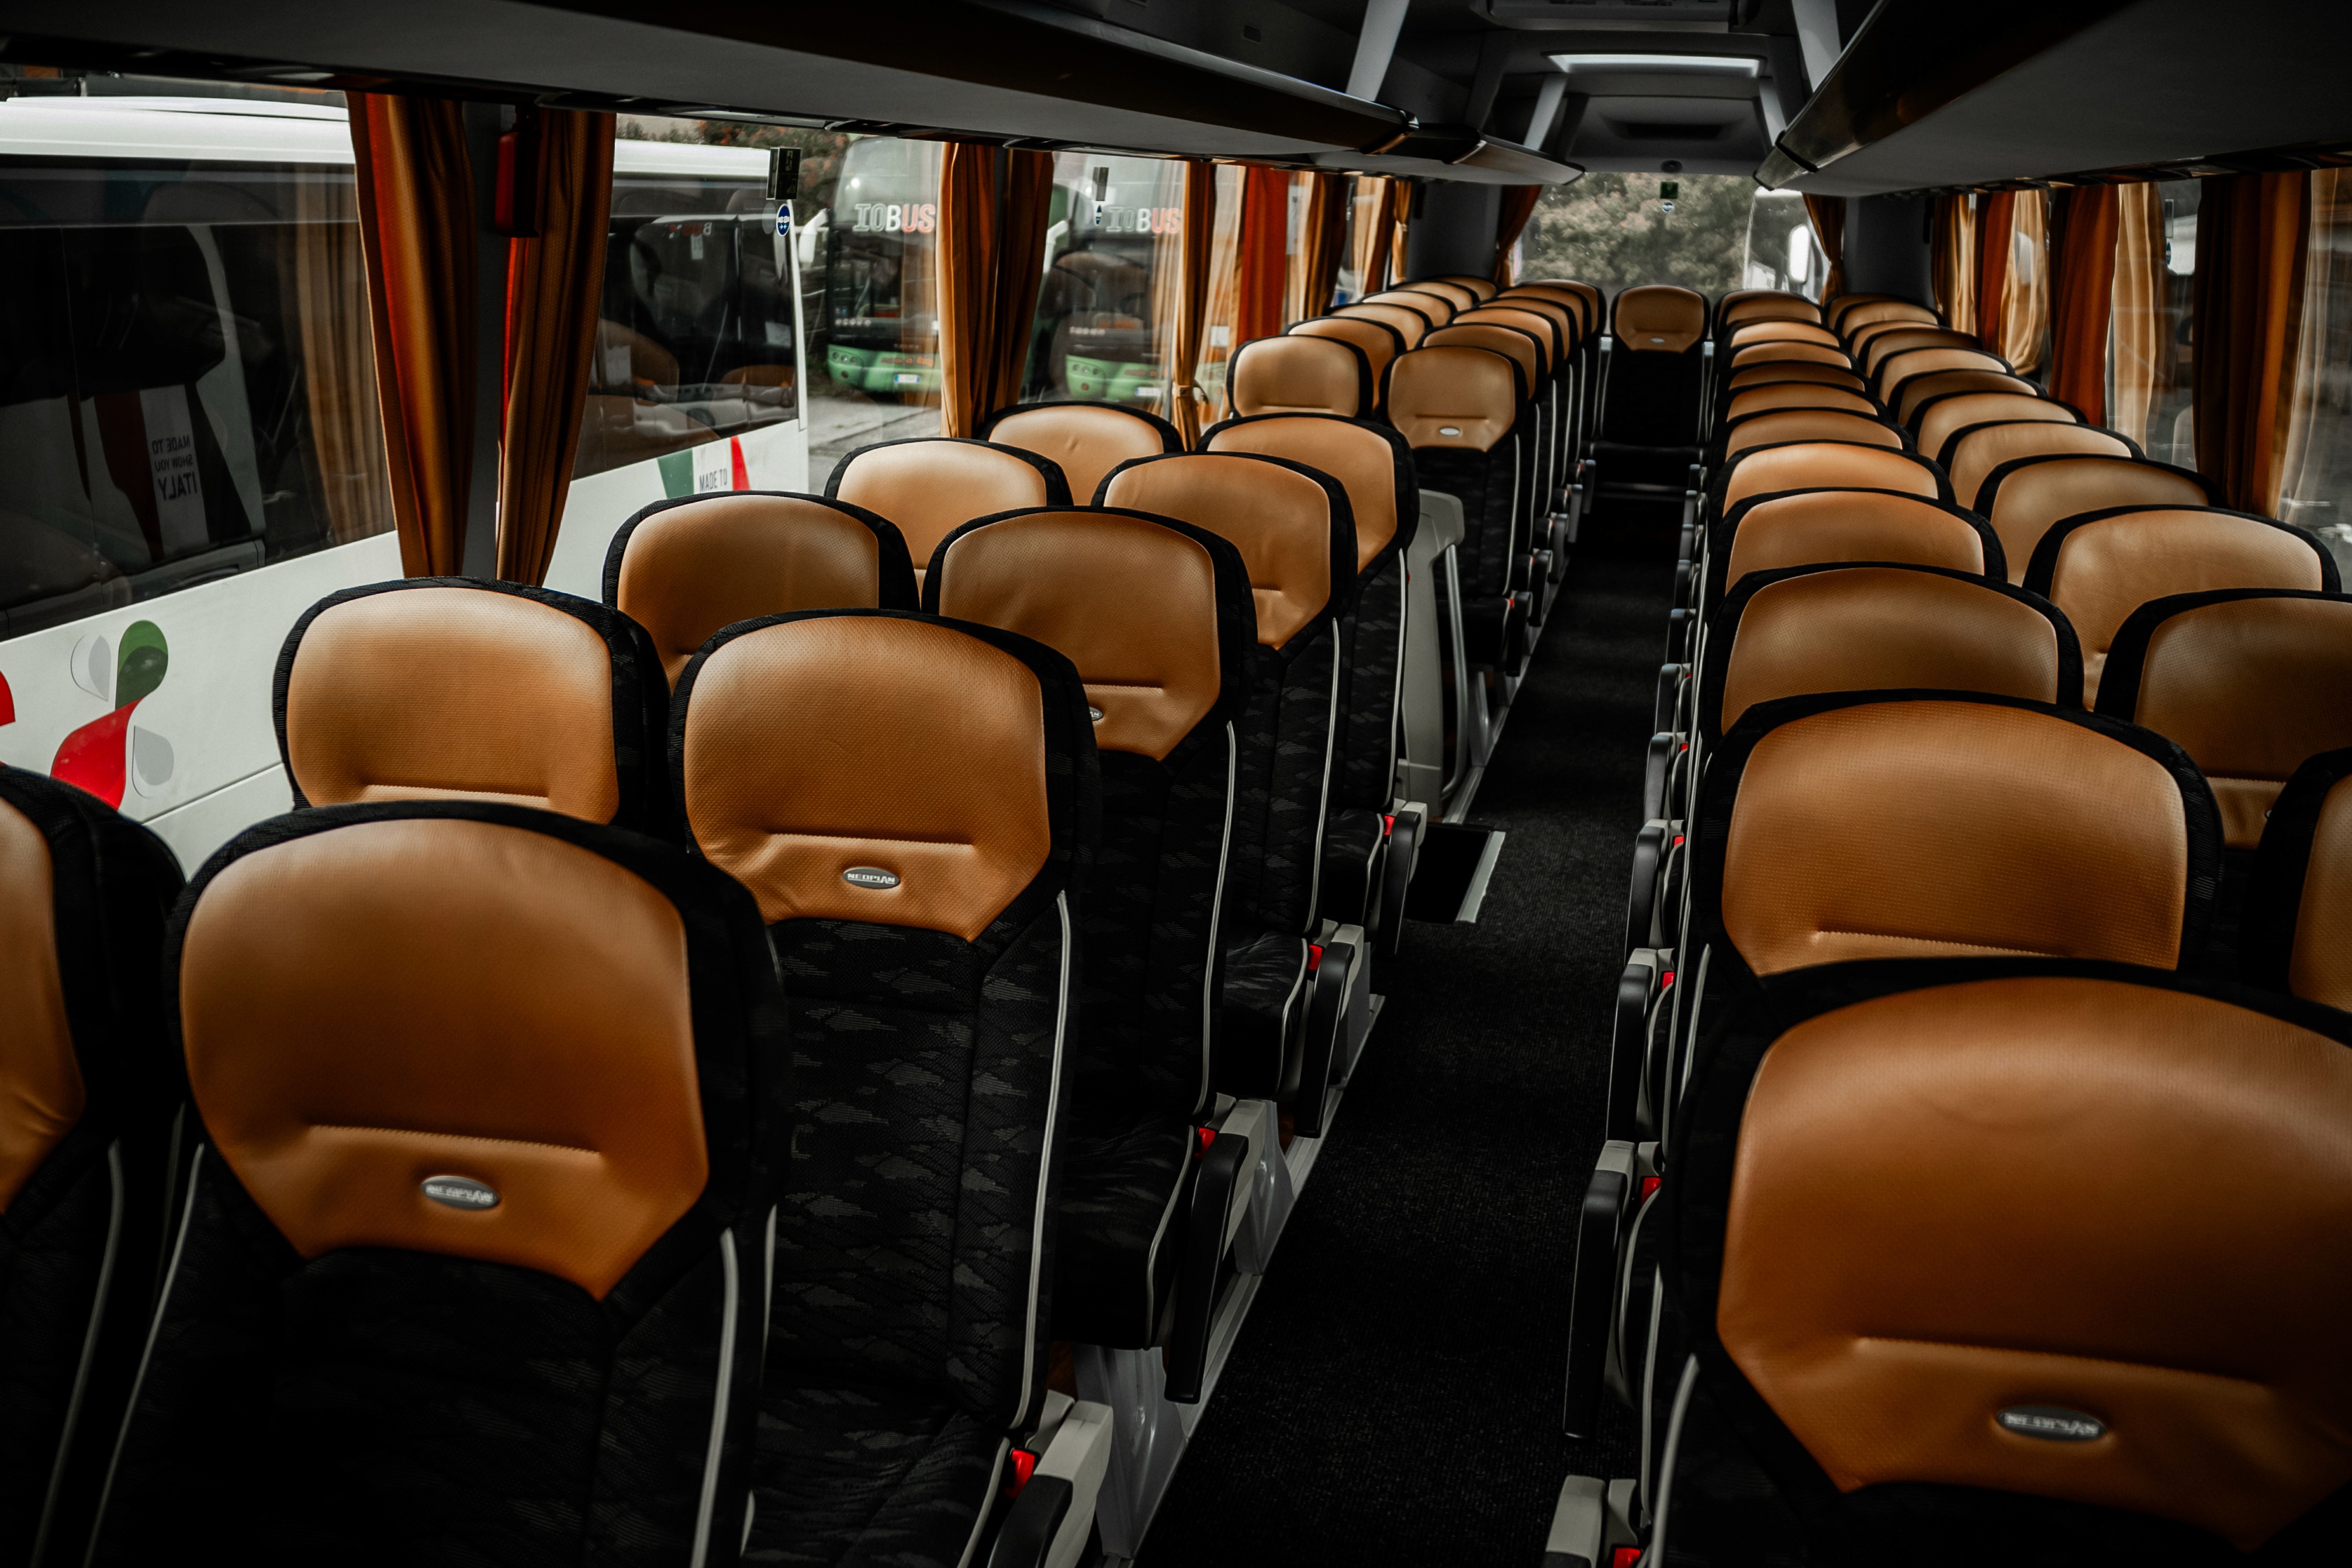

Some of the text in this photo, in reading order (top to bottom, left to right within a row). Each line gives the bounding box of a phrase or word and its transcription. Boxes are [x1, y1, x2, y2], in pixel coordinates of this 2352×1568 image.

[699, 468, 727, 493] MADE TO
[846, 873, 895, 885] NEOPLAN
